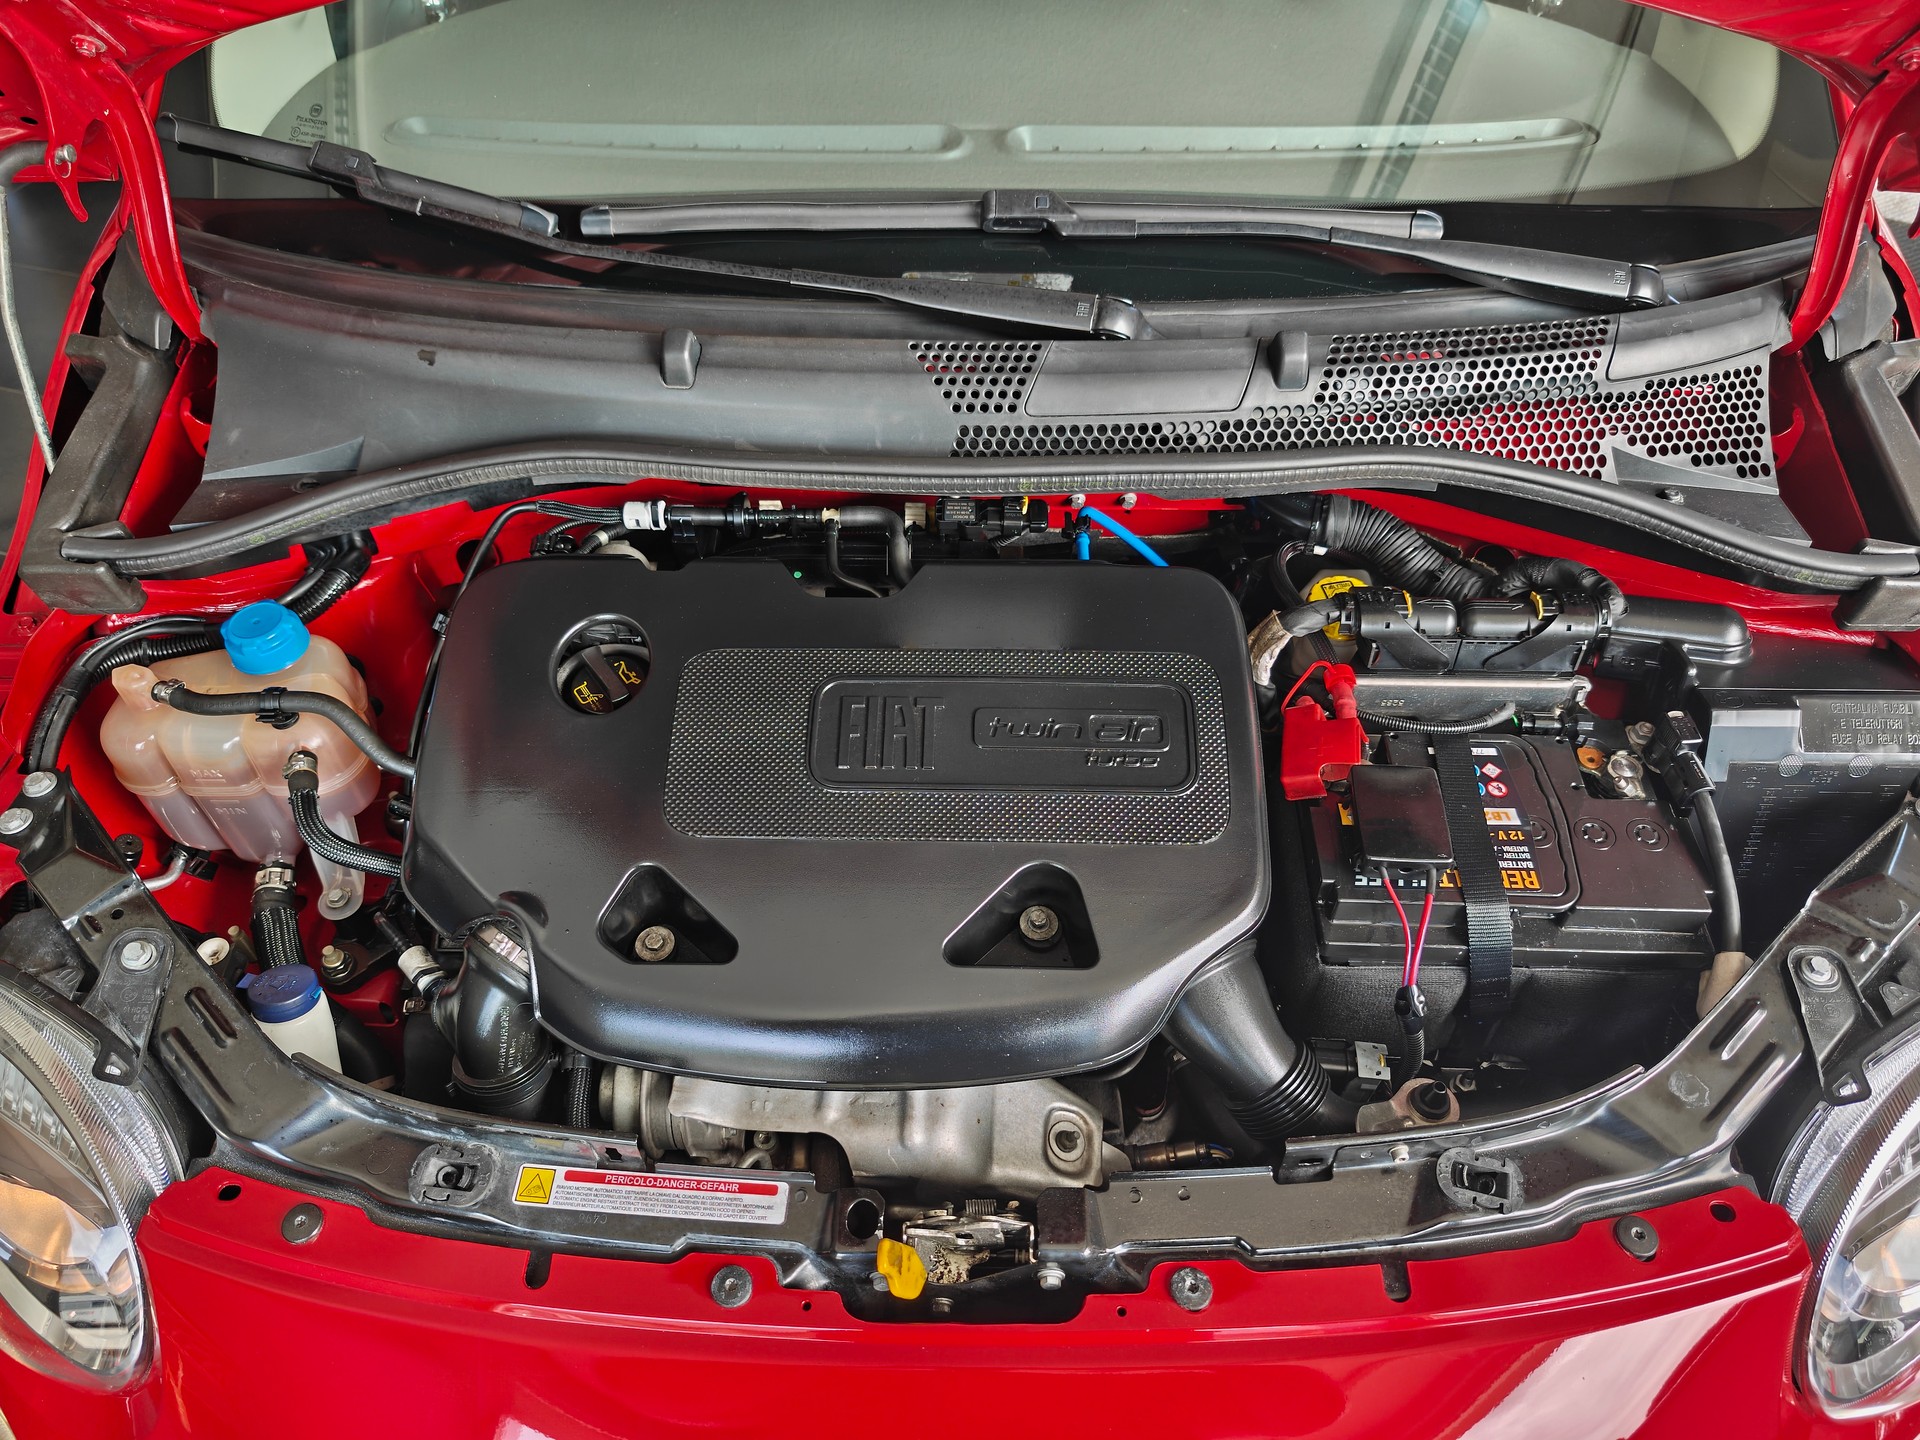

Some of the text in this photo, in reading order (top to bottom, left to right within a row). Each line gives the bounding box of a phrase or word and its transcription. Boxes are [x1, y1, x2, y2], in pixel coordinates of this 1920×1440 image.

[1075, 301, 1090, 317] FIAT
[989, 716, 1156, 742] twin air
[1841, 718, 1903, 730] E TELERUTTORI
[836, 696, 945, 770] FIAT
[1831, 733, 1852, 745] FUSE
[1857, 733, 1873, 745] AND
[1877, 733, 1903, 745] RELAY
[190, 769, 223, 778] MAX
[216, 807, 248, 815] MIN
[1498, 830, 1508, 840] V
[1508, 830, 1525, 841] 12
[604, 1175, 739, 1191] PERICOLO-DANGER-GEFAHR
